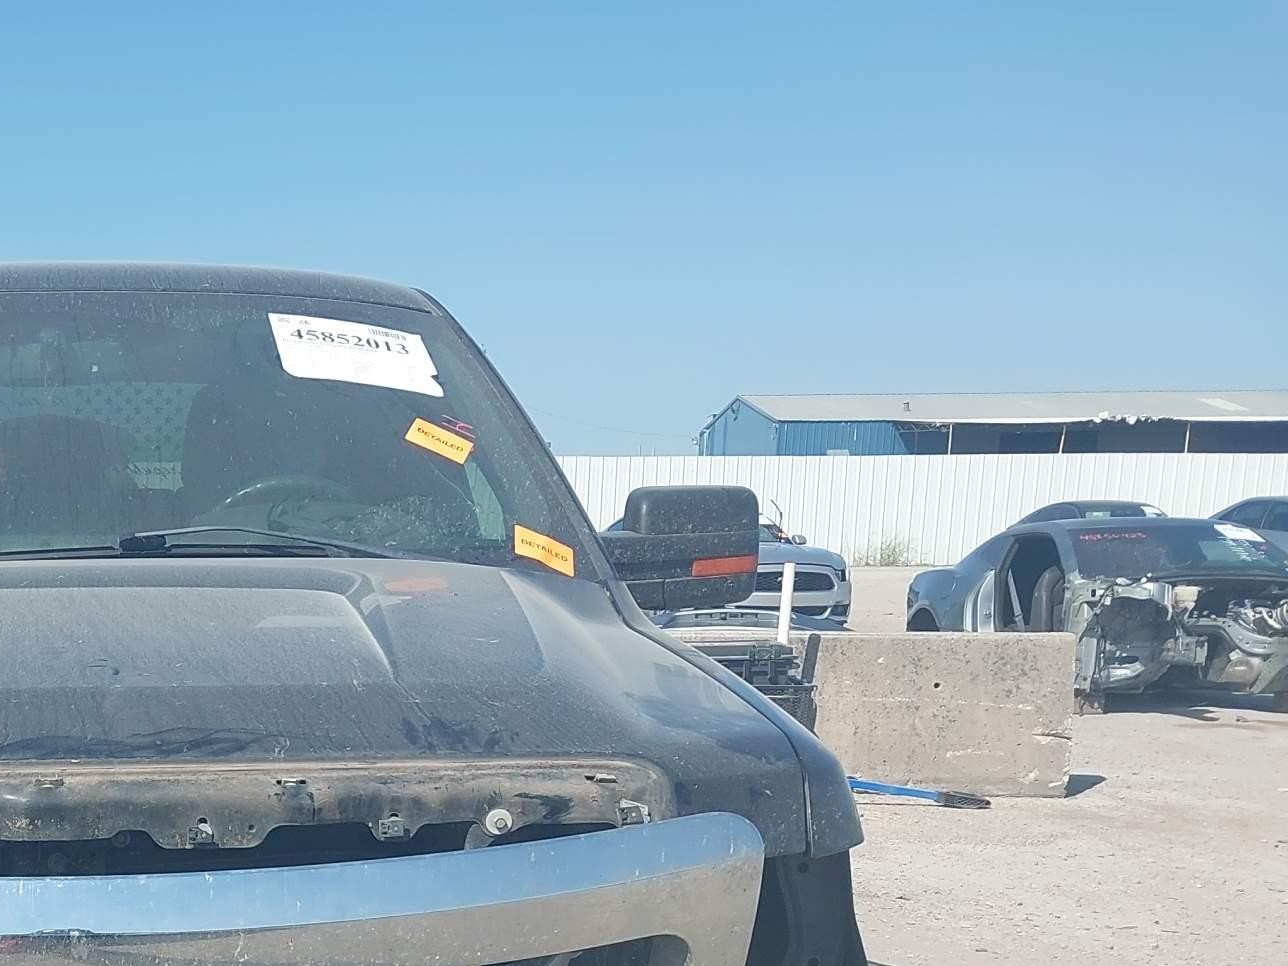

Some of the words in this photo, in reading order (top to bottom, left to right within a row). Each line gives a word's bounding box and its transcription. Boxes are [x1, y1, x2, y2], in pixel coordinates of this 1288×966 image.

[290, 328, 410, 355] 45852013
[417, 427, 464, 452] DETAILED
[521, 538, 568, 562] DETAILED
